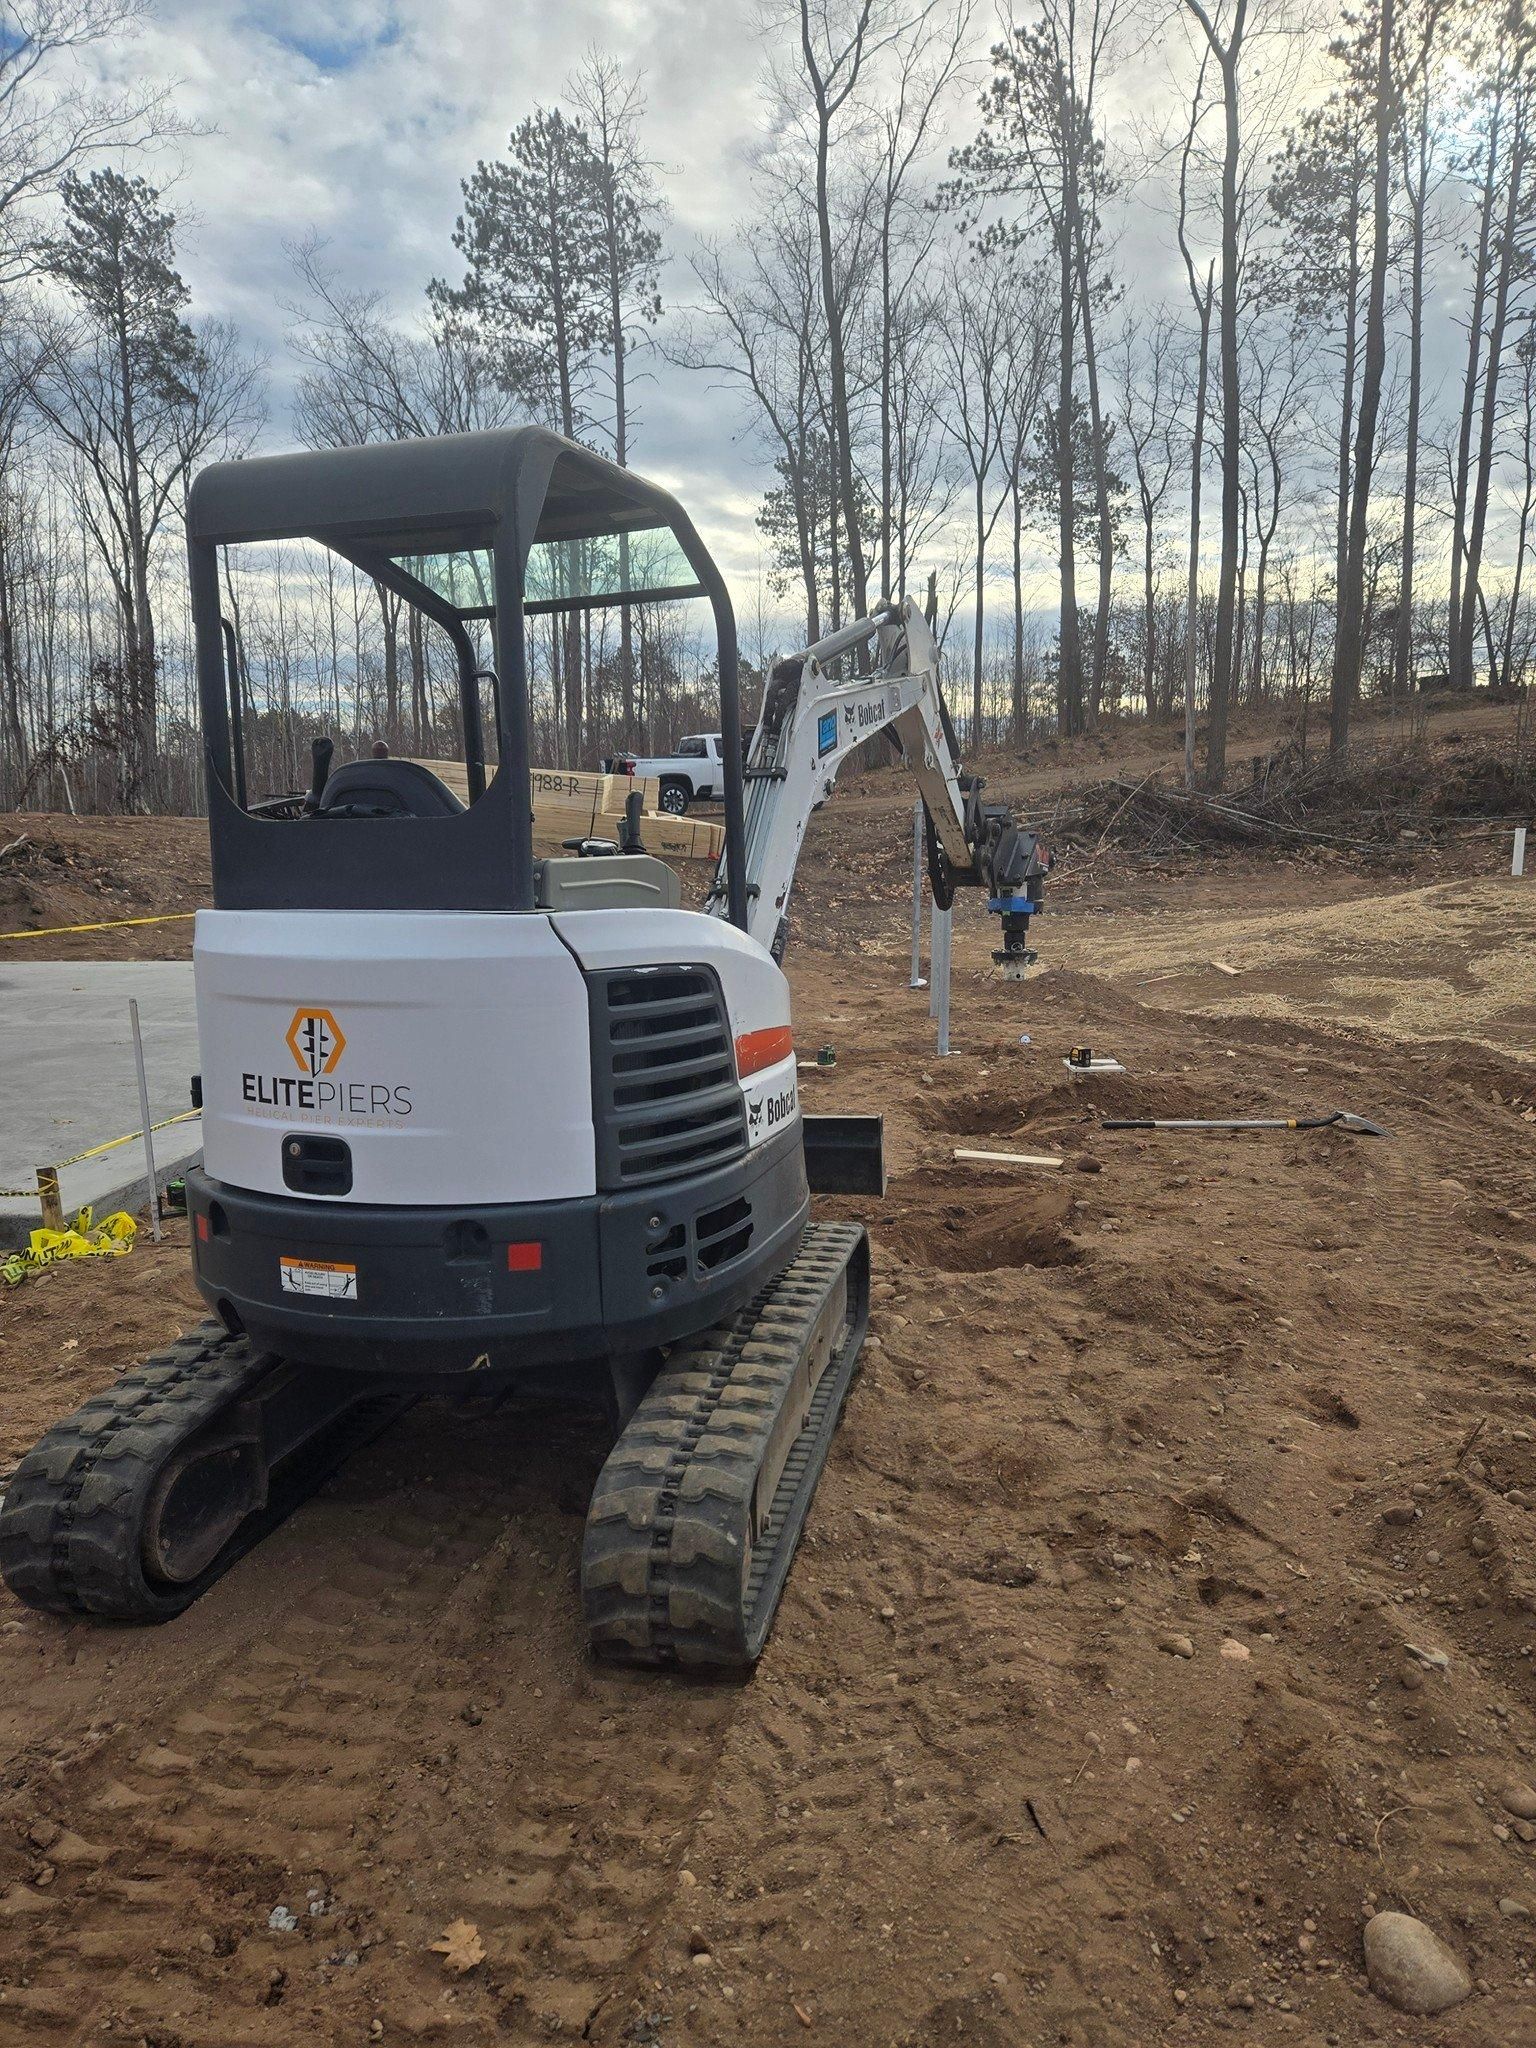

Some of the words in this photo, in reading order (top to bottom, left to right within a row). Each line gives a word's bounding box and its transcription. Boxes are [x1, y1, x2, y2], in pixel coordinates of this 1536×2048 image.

[857, 699, 886, 727] Bobcat
[767, 1083, 796, 1126] Bobcat
[247, 1106, 296, 1123] HELICAL
[301, 1113, 333, 1126] PIER
[337, 1116, 405, 1130] EXPERTS
[304, 1262, 335, 1271] WARNING
